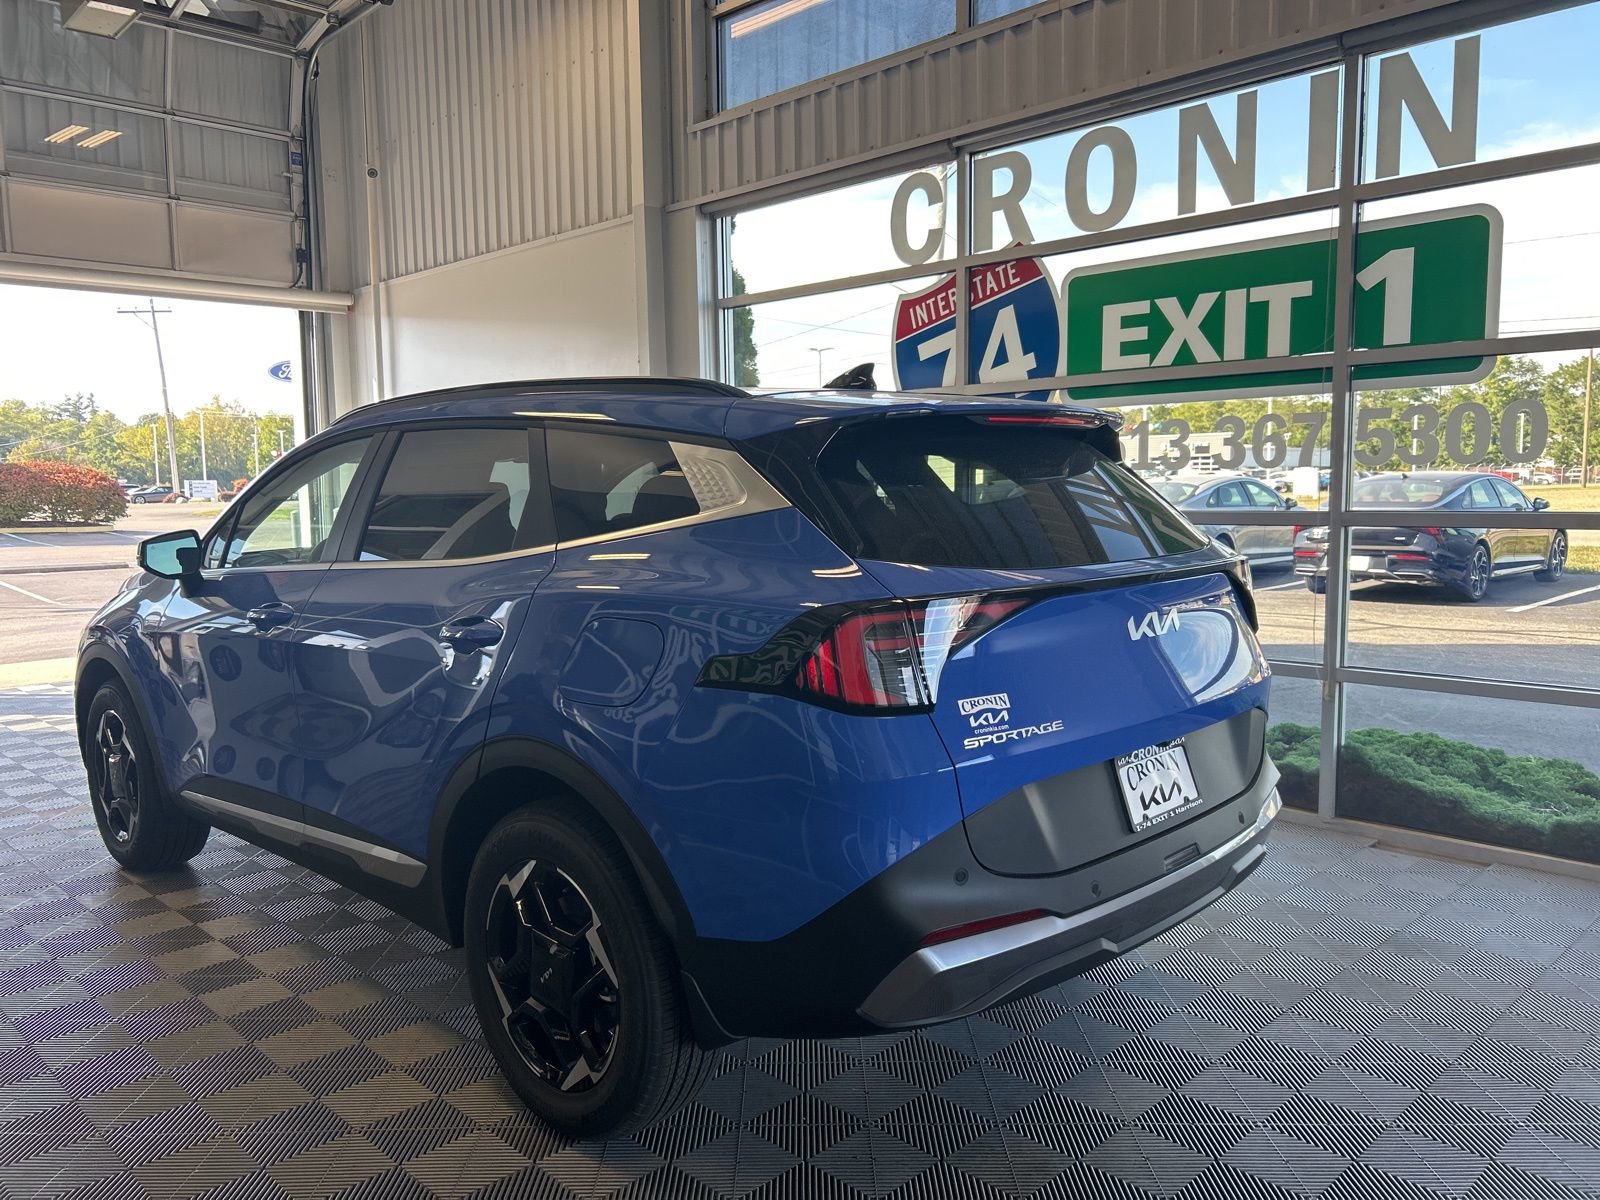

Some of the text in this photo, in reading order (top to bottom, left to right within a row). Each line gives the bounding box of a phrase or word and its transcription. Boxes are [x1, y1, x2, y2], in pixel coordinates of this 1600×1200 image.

[890, 33, 1482, 266] CRONIN
[909, 260, 1020, 330] INTERTATE
[1101, 246, 1415, 371] EXIT 1
[1127, 607, 1180, 641] KIA
[961, 695, 1008, 713] CRONIN
[969, 709, 1009, 728] KIA
[963, 719, 1065, 750] SPORTAGE
[974, 724, 1010, 735] croninkia.com
[1126, 750, 1181, 791] CRONIN
[1139, 777, 1182, 812] KIA
[1152, 813, 1168, 825] EXIT
[1175, 798, 1203, 815] Harrison
